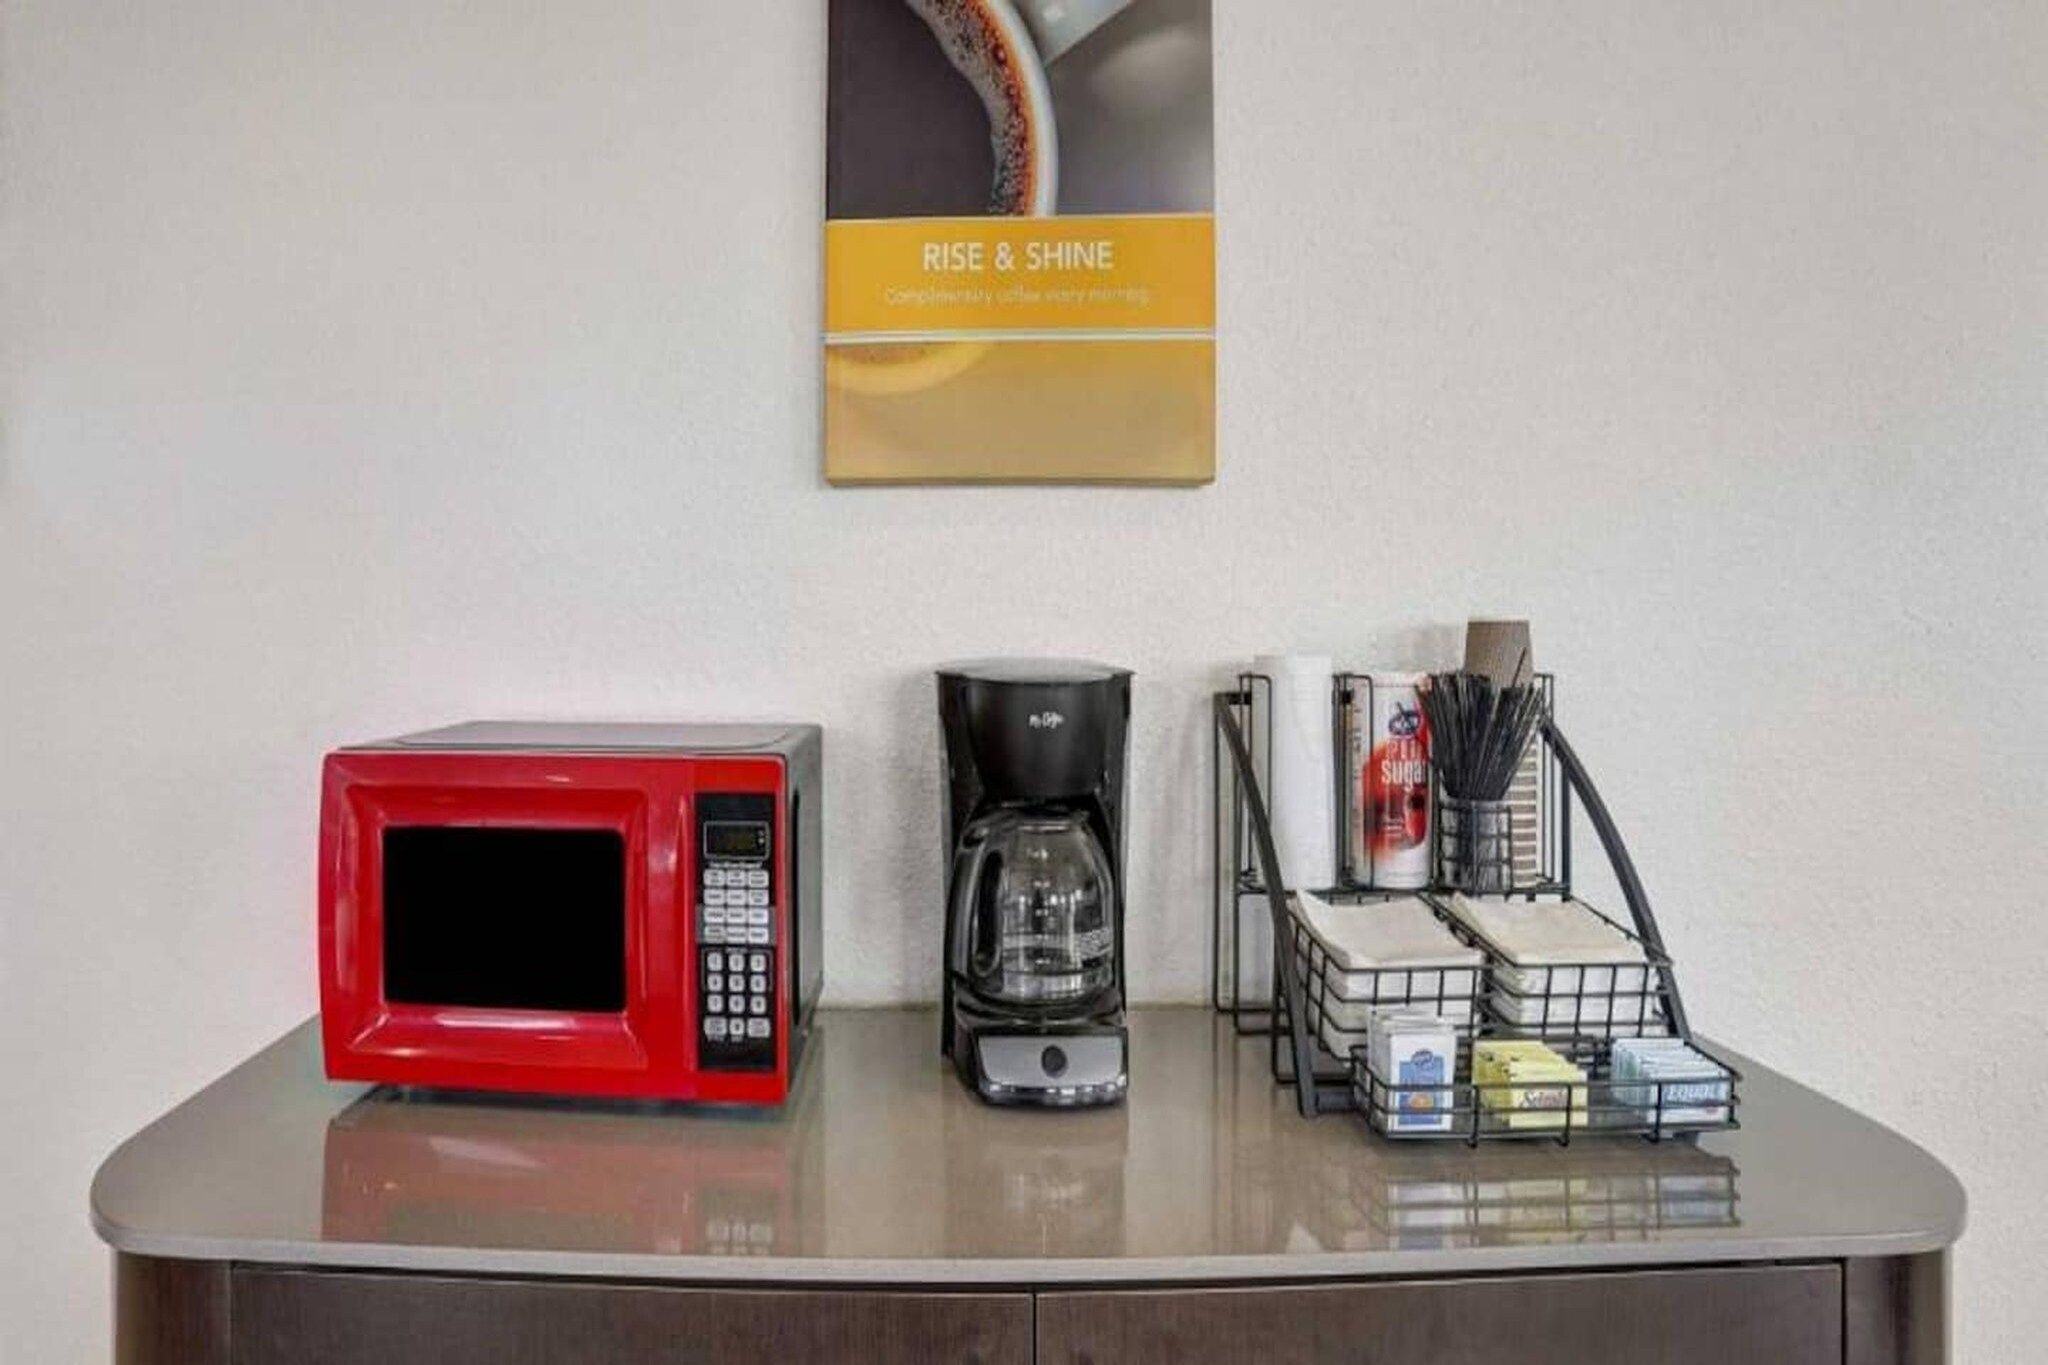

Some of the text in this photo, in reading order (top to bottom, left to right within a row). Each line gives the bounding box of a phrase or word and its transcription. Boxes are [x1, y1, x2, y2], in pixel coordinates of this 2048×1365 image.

[923, 240, 1114, 271] RISE & SHINE
